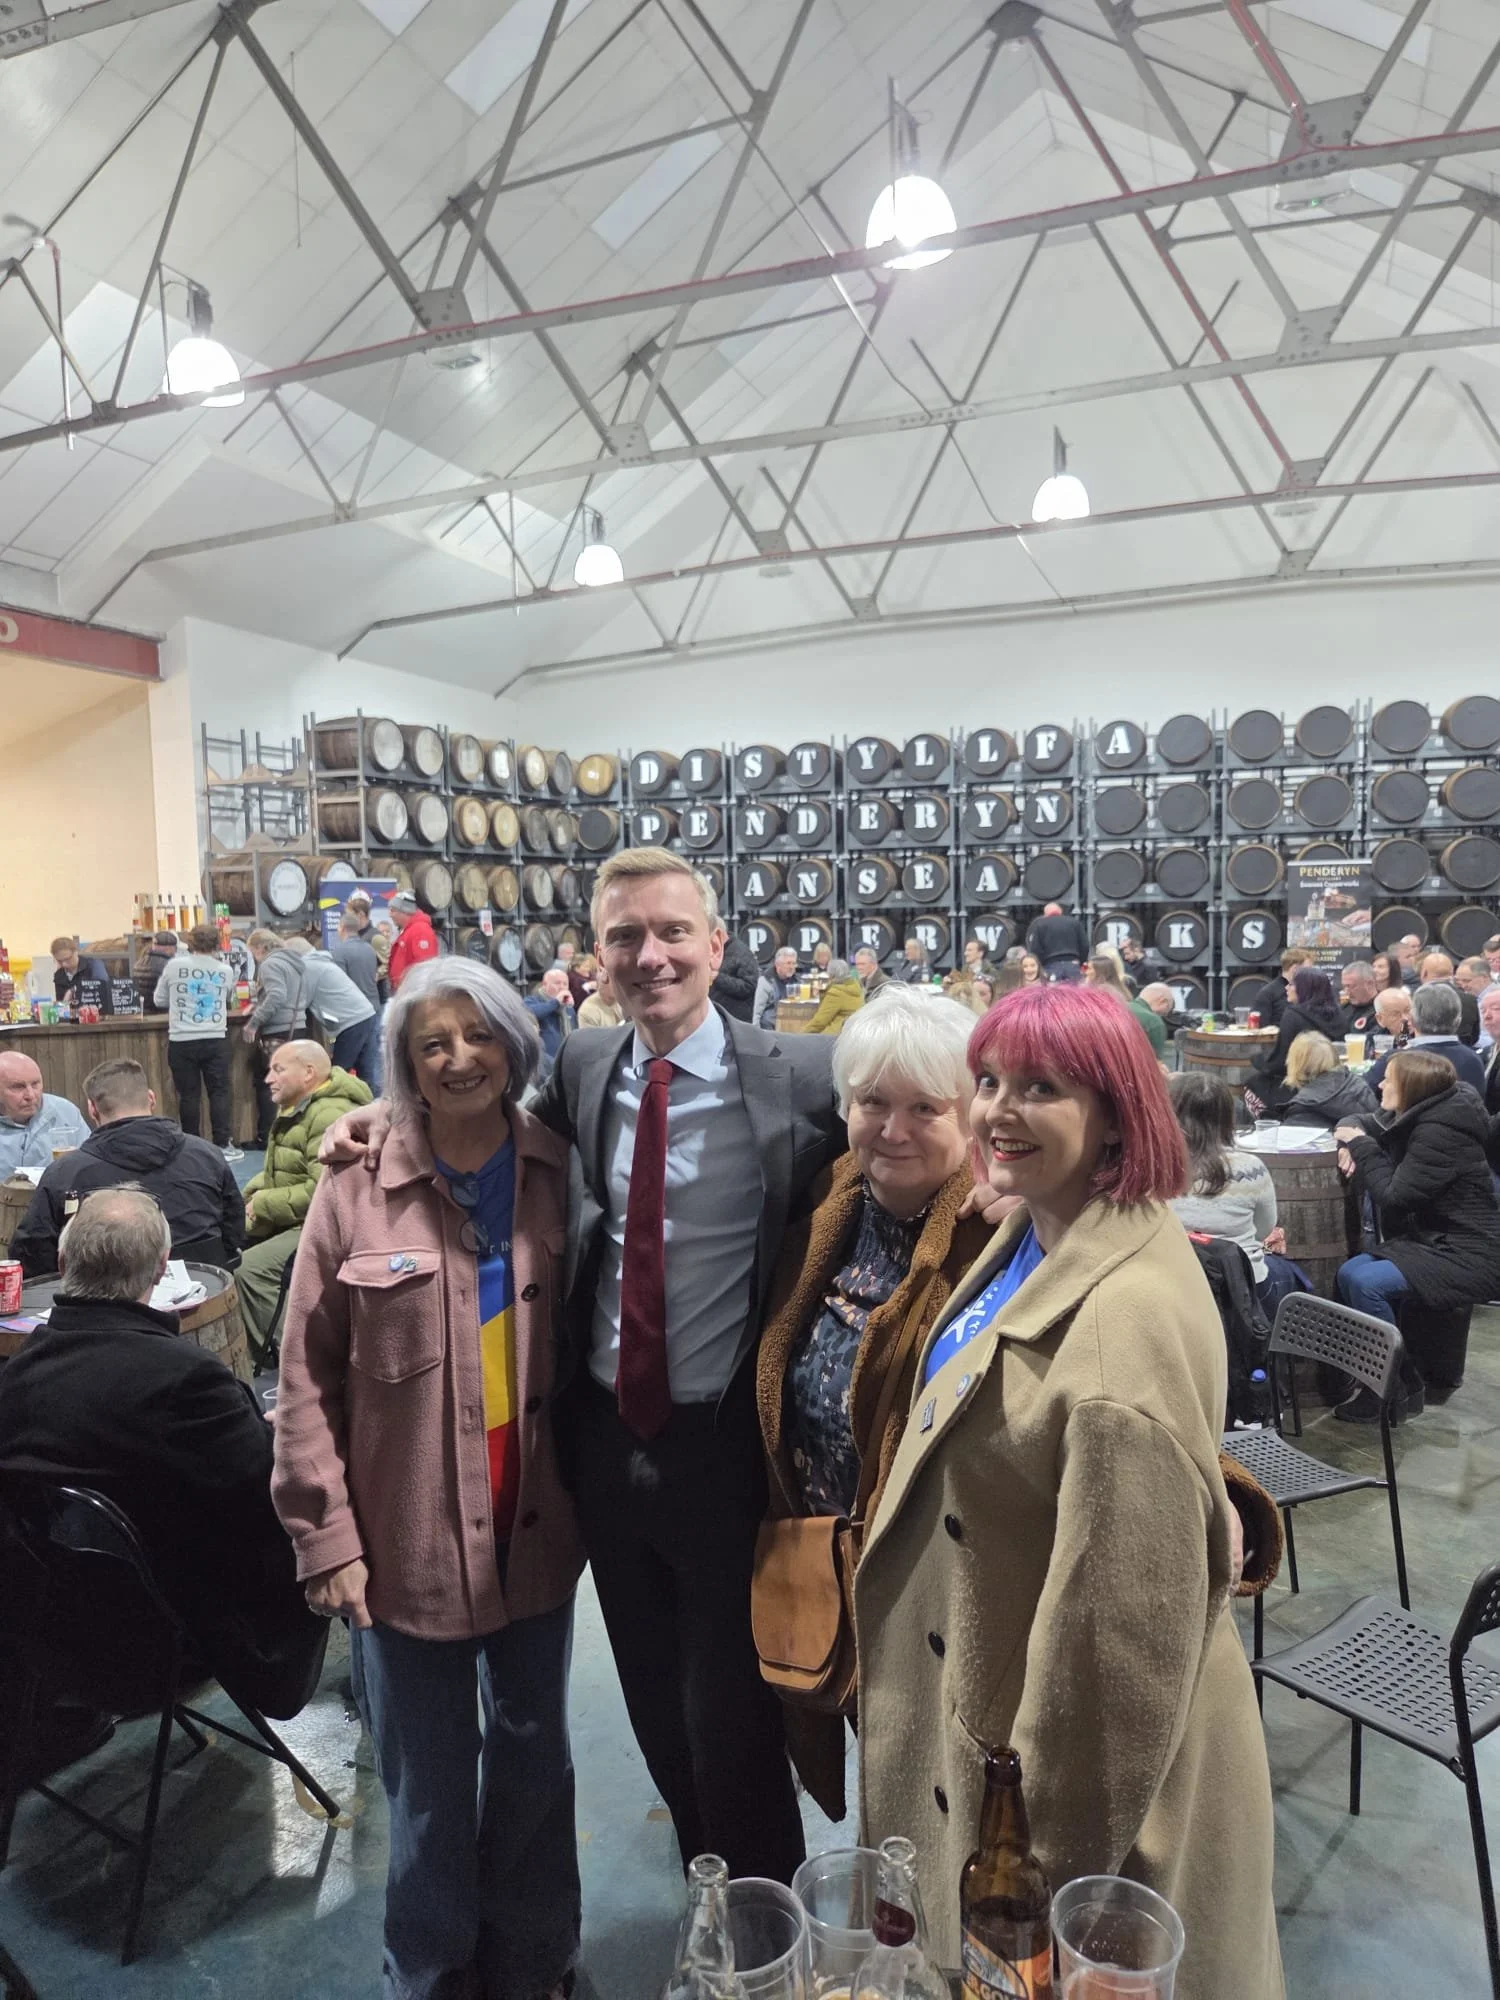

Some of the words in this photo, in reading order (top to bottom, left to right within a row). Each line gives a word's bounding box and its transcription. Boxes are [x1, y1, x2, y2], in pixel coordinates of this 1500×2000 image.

[641, 796, 1059, 840] PENDERYN
[1299, 866, 1360, 877] PENDERYN
[178, 967, 226, 984] BOYS
